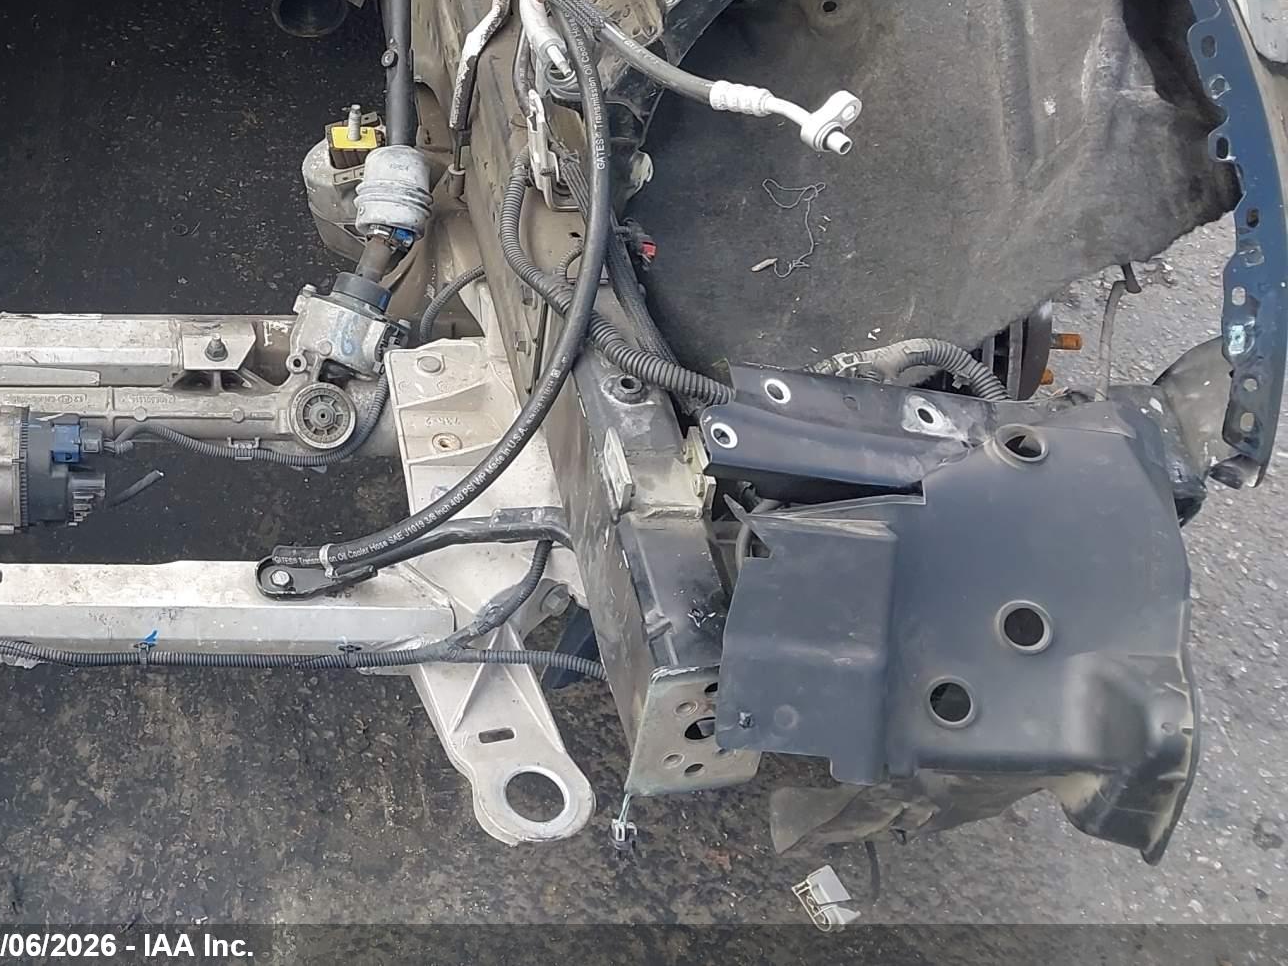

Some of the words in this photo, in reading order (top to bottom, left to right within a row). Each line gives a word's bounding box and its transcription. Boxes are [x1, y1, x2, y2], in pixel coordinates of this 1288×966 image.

[576, 36, 590, 65] Cooler
[588, 77, 604, 129] Transmission
[337, 552, 346, 562] Oil
[347, 546, 369, 558] Cooler
[370, 540, 389, 552] Hose
[388, 531, 404, 544] SAE
[404, 520, 425, 537] J1019
[450, 493, 464, 507] 400
[464, 482, 477, 497] PSI
[487, 454, 505, 475] Made
